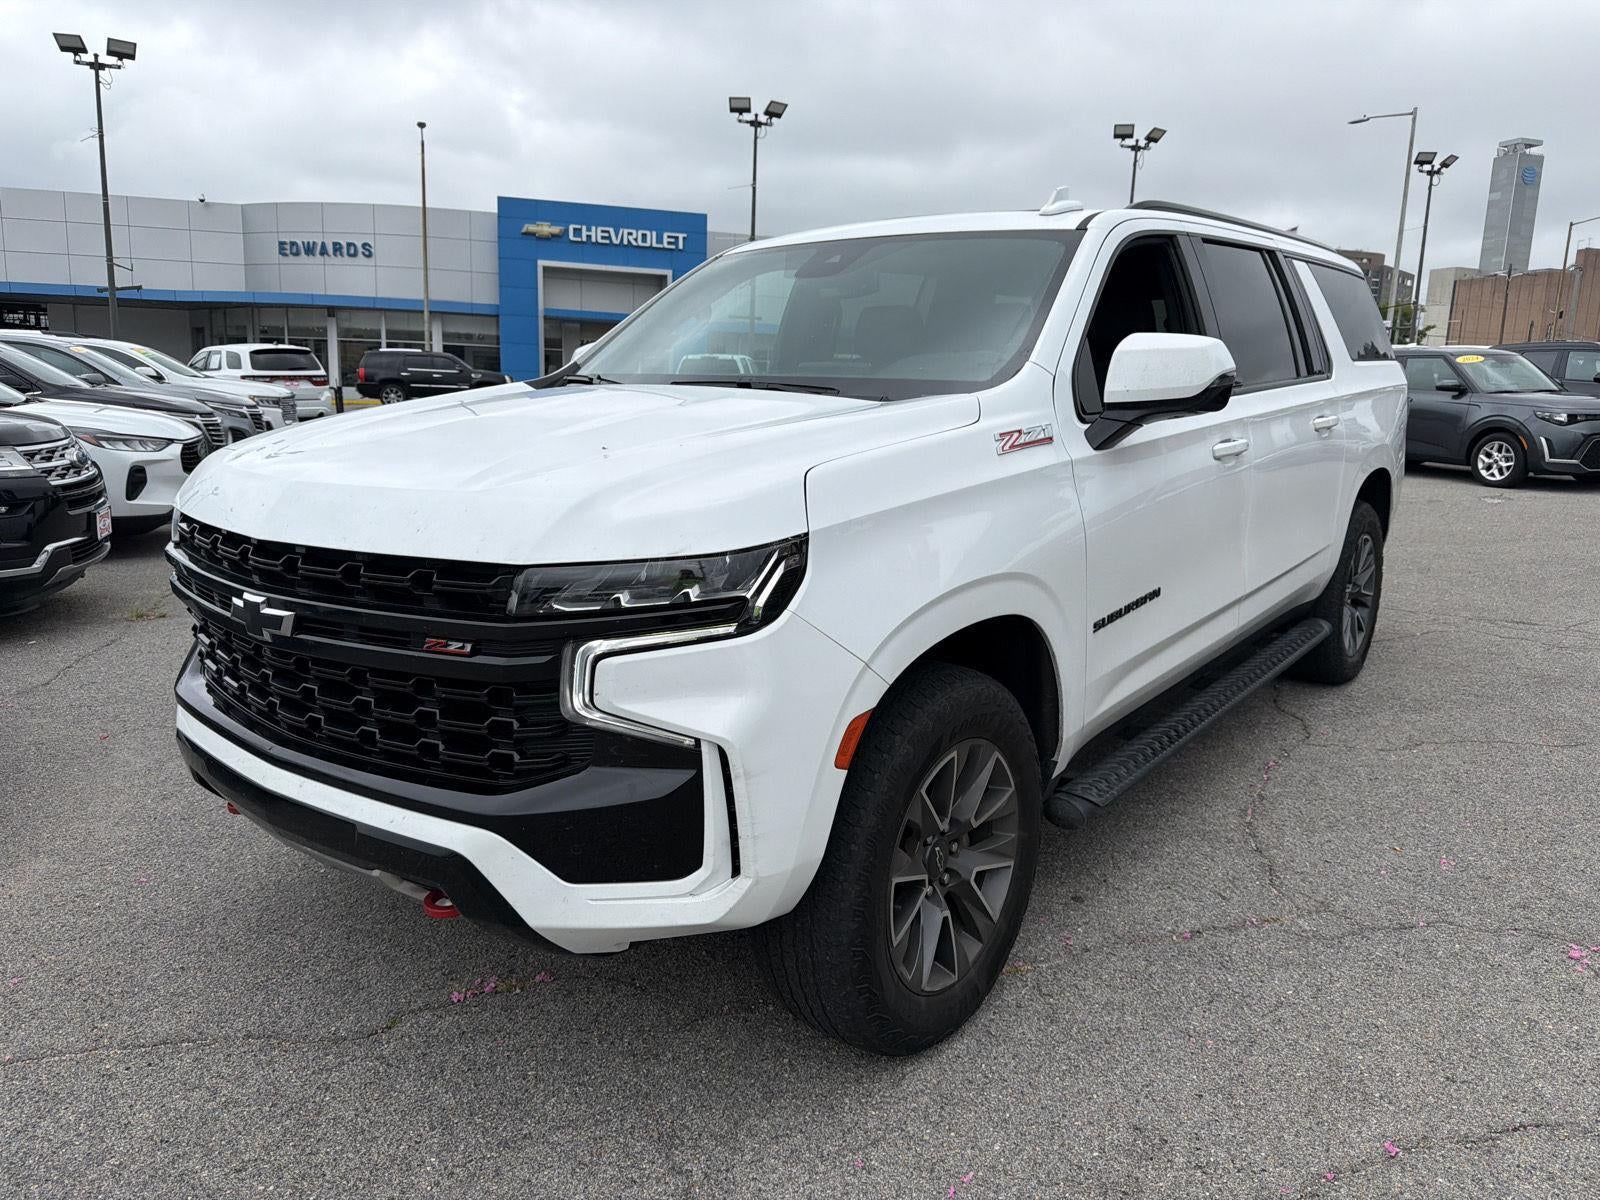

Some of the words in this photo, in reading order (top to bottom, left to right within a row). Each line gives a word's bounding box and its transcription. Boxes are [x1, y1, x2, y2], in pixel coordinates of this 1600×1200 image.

[278, 240, 373, 258] EDWARDS
[568, 224, 687, 250] CHEVROLET
[993, 423, 1054, 456] Z71
[1093, 586, 1161, 633] SUBURBAN
[423, 637, 472, 656] Z71
